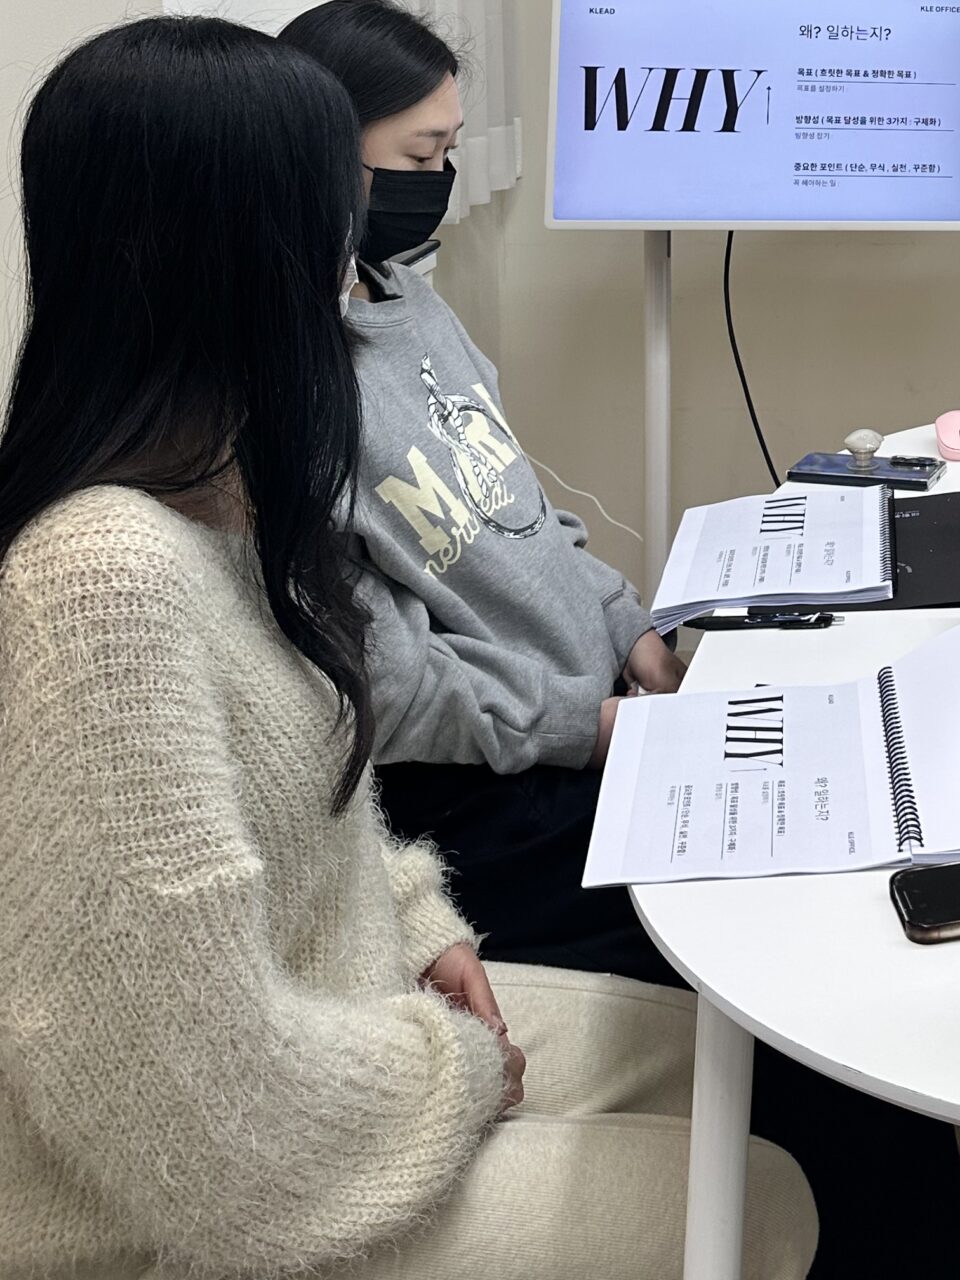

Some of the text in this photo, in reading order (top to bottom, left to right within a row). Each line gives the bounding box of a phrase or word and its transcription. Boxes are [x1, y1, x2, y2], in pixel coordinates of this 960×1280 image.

[799, 24, 892, 41] 왜? 일하는지?
[845, 69, 860, 78] 목표
[897, 70, 912, 79] 목표
[580, 66, 768, 133] WHY
[826, 116, 841, 125] 목표
[760, 495, 808, 537] WHY
[724, 693, 784, 767] WHY
